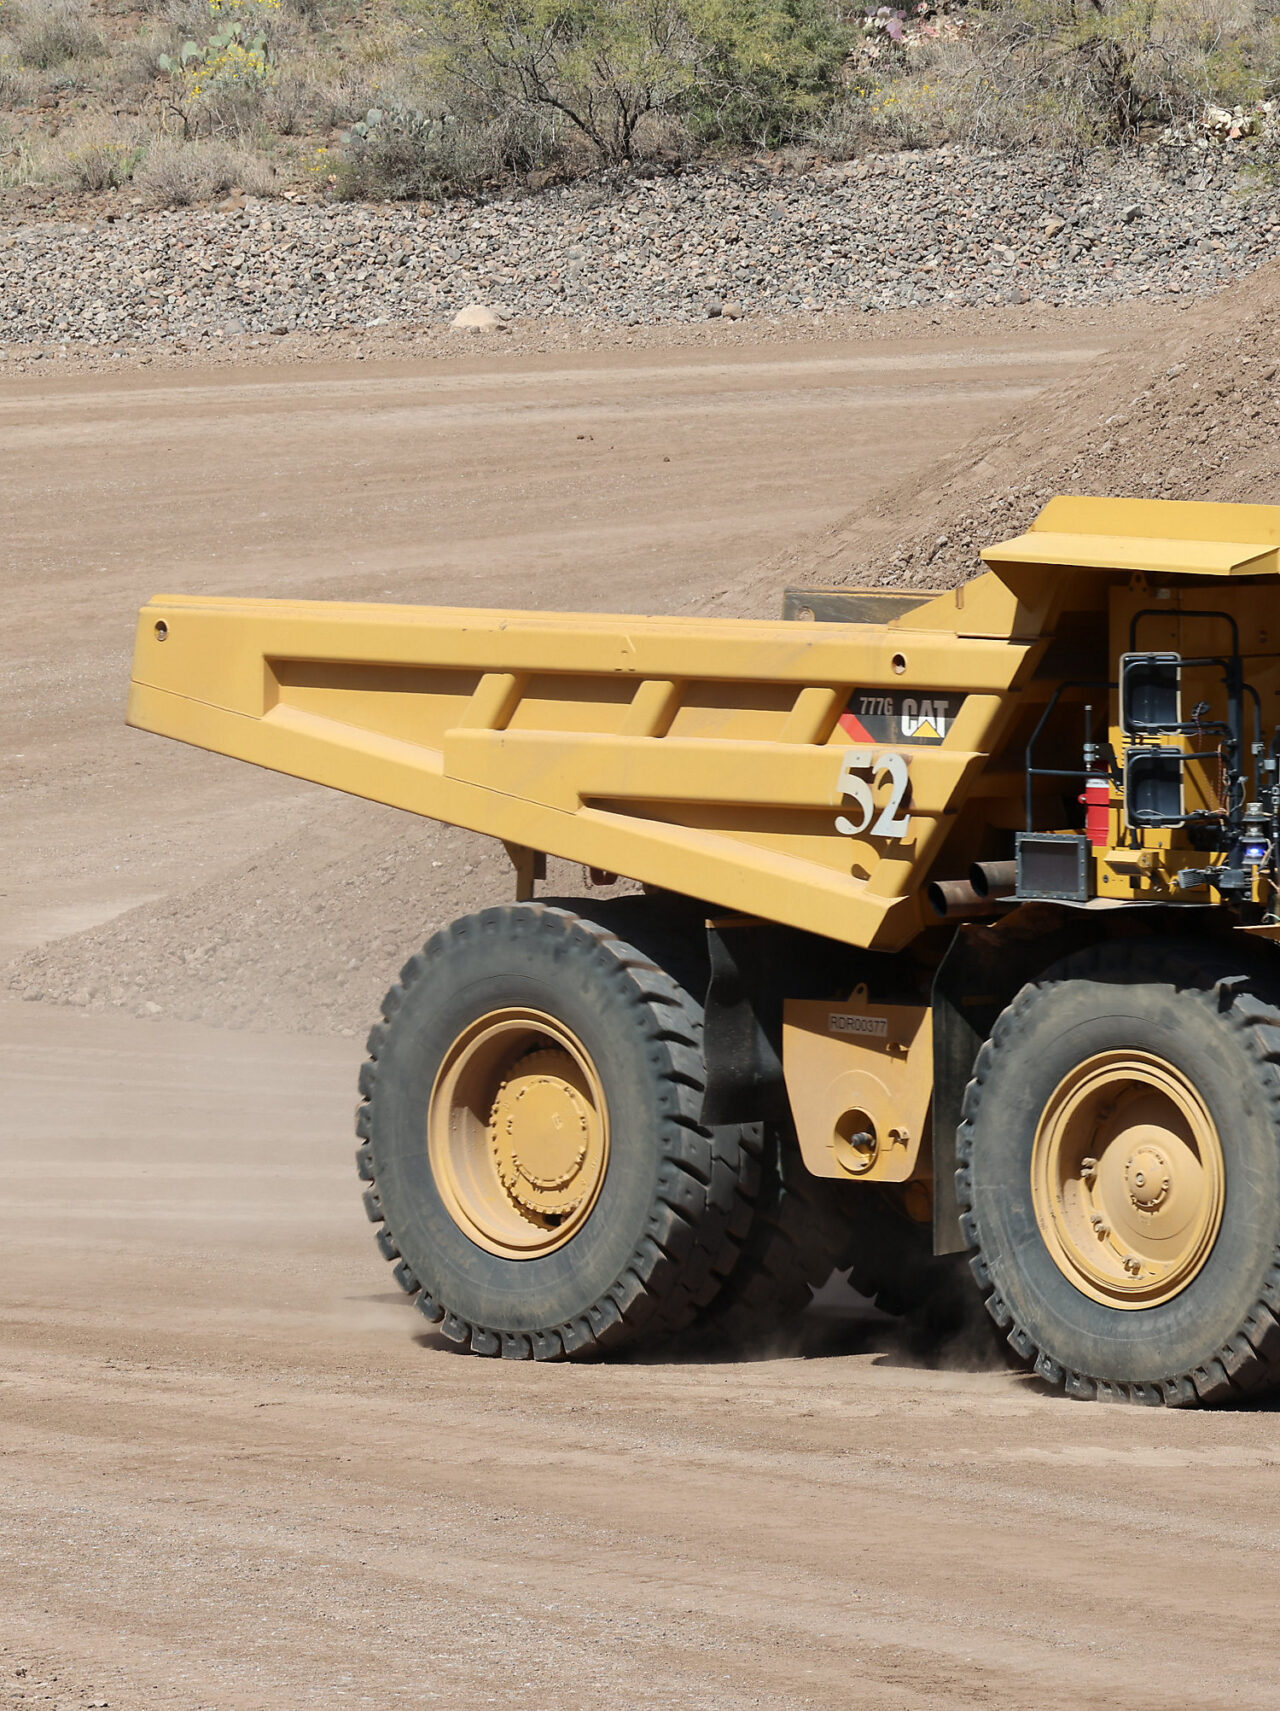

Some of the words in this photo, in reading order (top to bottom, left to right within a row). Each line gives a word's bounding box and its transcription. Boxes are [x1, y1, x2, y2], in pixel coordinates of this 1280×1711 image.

[860, 697, 893, 715] 777G
[901, 698, 949, 738] CAT
[835, 750, 911, 838] 52
